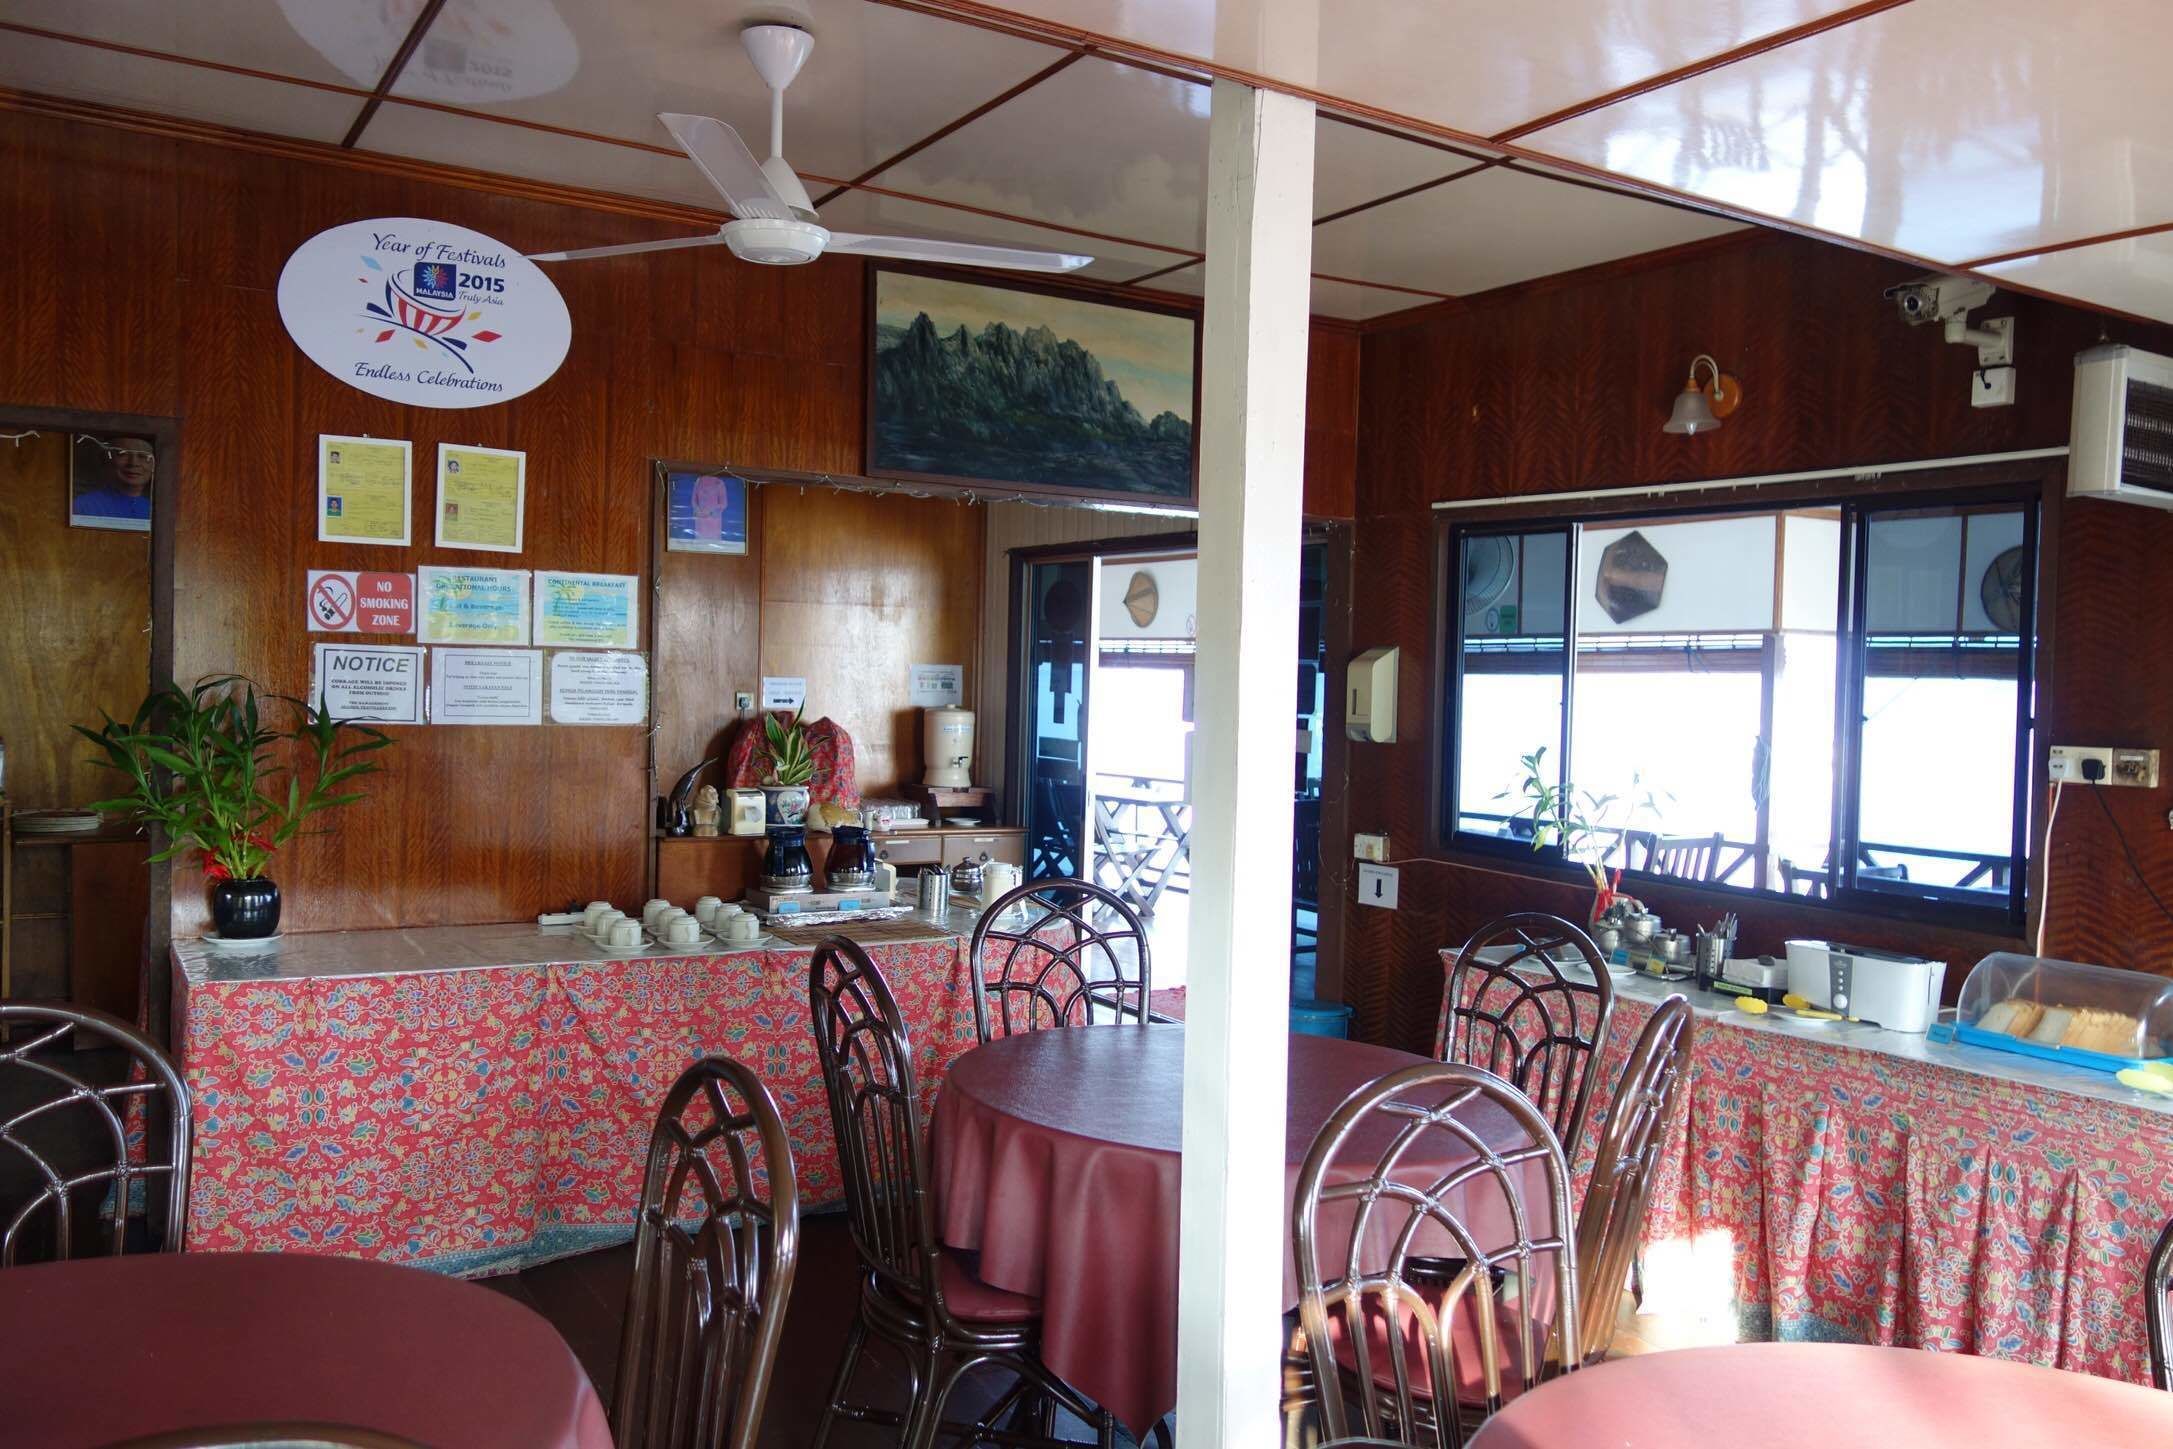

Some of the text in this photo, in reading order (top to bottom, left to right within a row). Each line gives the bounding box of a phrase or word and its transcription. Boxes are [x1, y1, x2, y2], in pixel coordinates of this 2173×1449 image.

[371, 232, 507, 269] Year of Festivals
[458, 272, 505, 293] 2015
[415, 287, 455, 299] MALAYSIA
[458, 290, 504, 306] Truly Asia
[354, 361, 504, 393] Endless Celebrations
[376, 581, 392, 593] NO
[360, 597, 409, 610] SMOKING
[371, 614, 401, 626] ZONE
[332, 655, 410, 673] NOTICE
